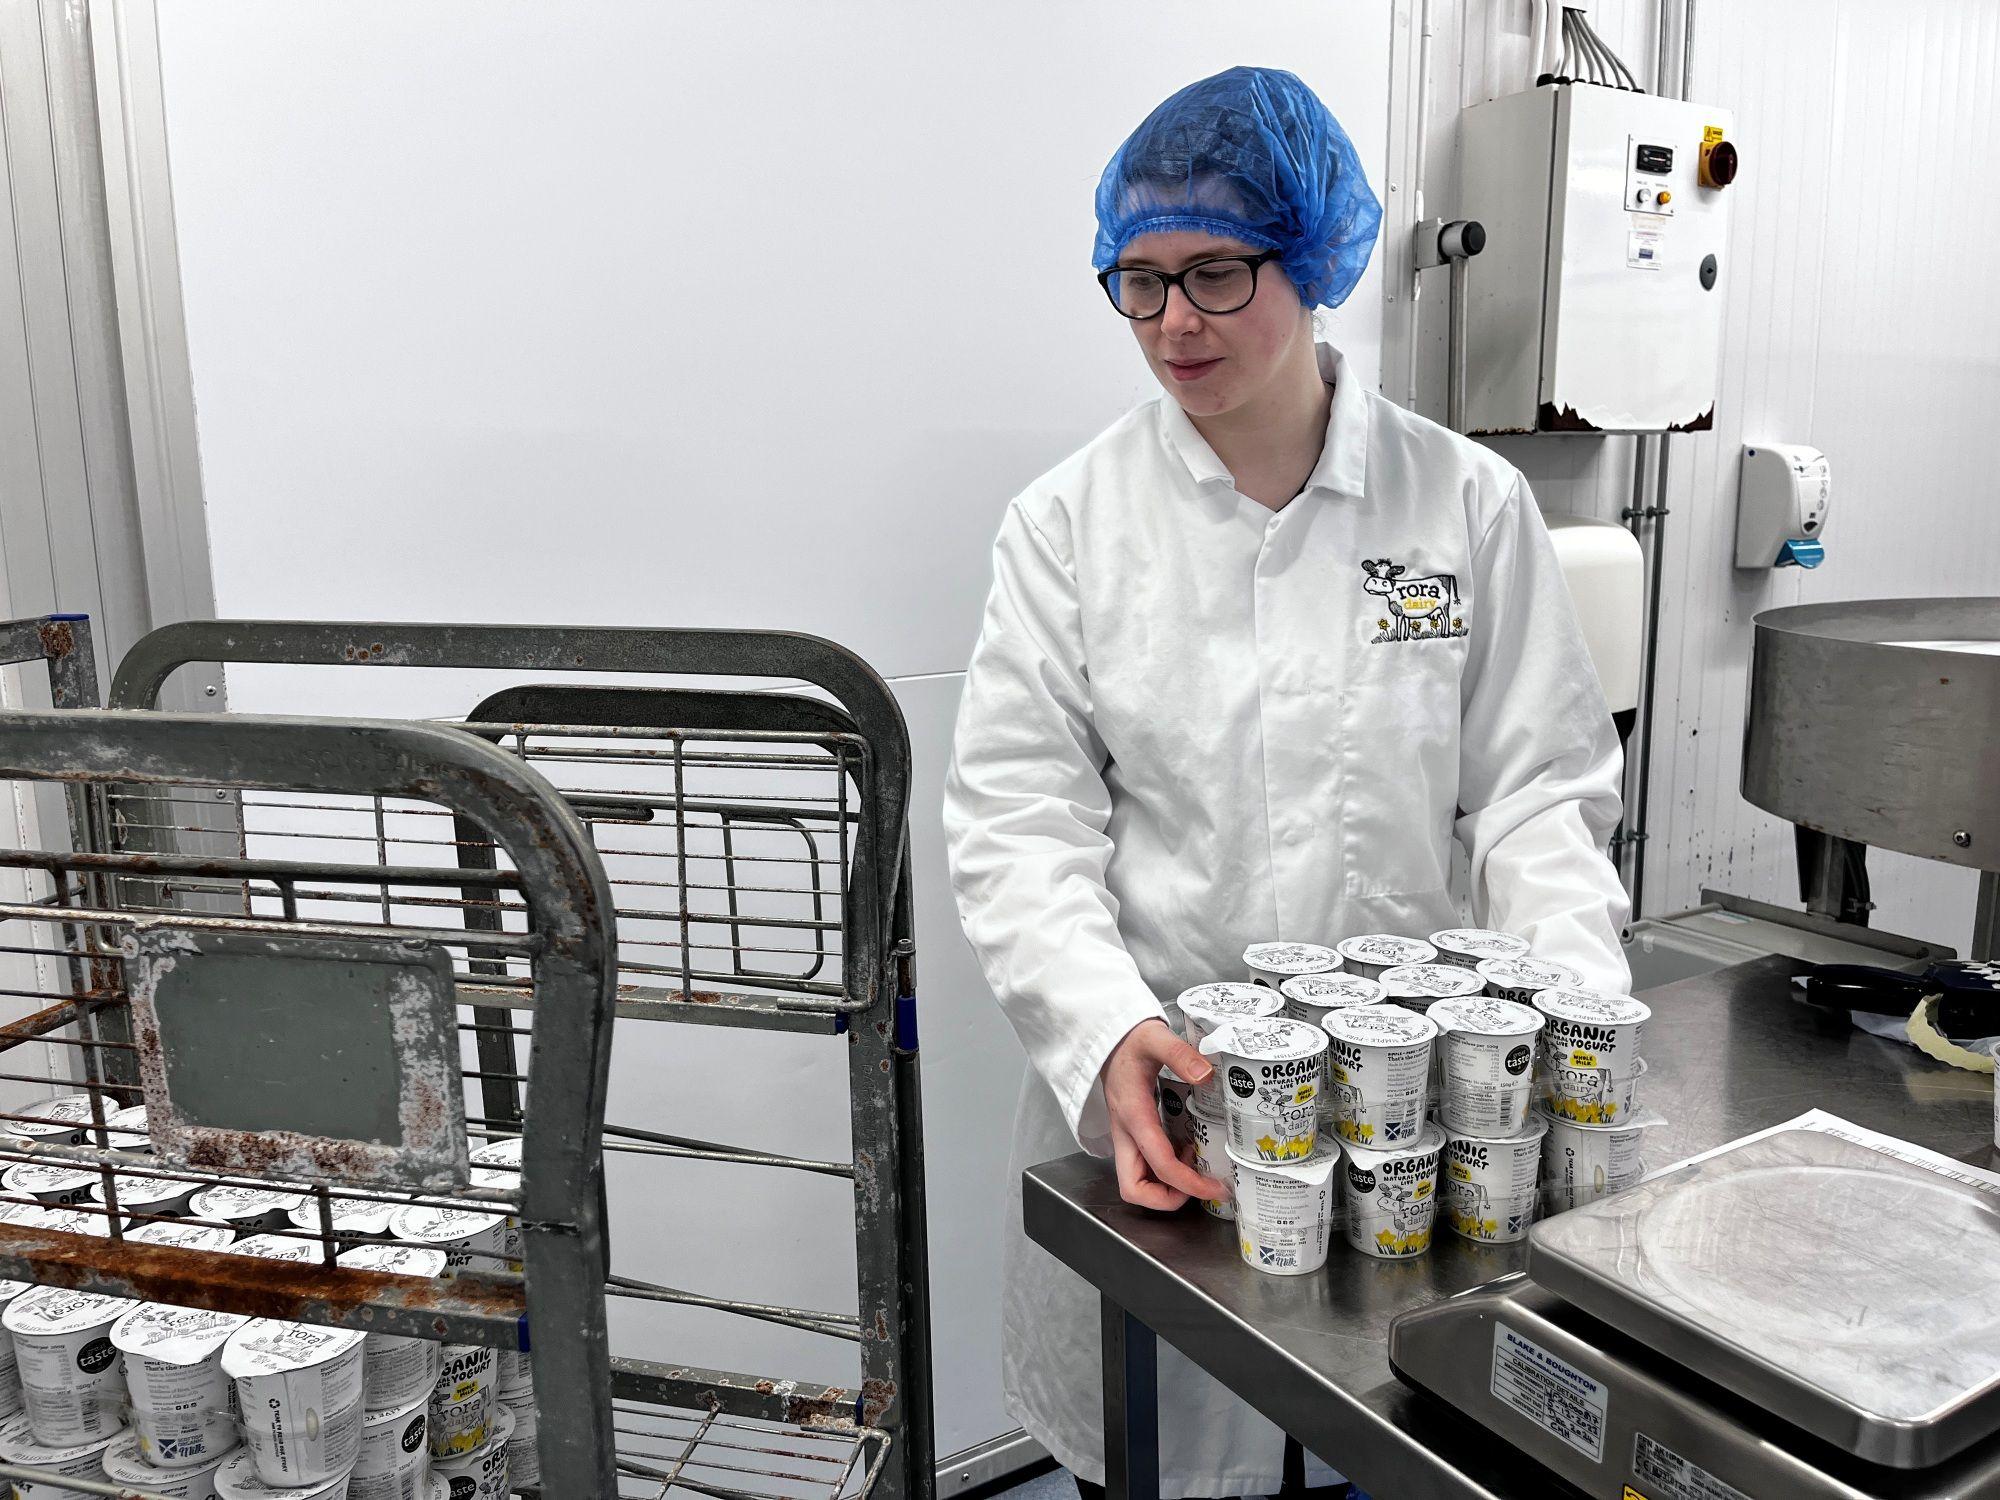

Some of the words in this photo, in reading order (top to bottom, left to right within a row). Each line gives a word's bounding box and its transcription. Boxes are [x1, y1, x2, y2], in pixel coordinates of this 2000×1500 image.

[1396, 584, 1441, 600] rora
[1403, 598, 1438, 610] dairy
[1544, 1017, 1616, 1042] ORGANIC
[1569, 1038, 1616, 1053] YOGURT
[1507, 1054, 1530, 1068] taste
[1230, 1077, 1254, 1089] taste
[1558, 1069, 1598, 1087] rora
[1563, 1082, 1592, 1093] dairy
[1281, 1105, 1314, 1122] rora
[1255, 1180, 1272, 1188] That's
[1350, 1171, 1375, 1184] taste
[1401, 1200, 1432, 1219] rora
[1275, 1256, 1298, 1267] Milk
[168, 1311, 211, 1327] rora
[287, 1329, 320, 1344] rora
[79, 1346, 115, 1367] taste
[1507, 1333, 1534, 1356] BLAKE
[1536, 1352, 1543, 1361] &
[1545, 1357, 1597, 1392] BOUGHTON
[145, 1364, 165, 1372] That's
[451, 1358, 491, 1384] YOGURT
[1512, 1358, 1556, 1388] CALIBRATION
[1556, 1384, 1584, 1406] DETAILS
[438, 1399, 480, 1422] rora
[403, 1422, 426, 1447] taste
[178, 1444, 206, 1457] Milk
[450, 1482, 476, 1498] aste
